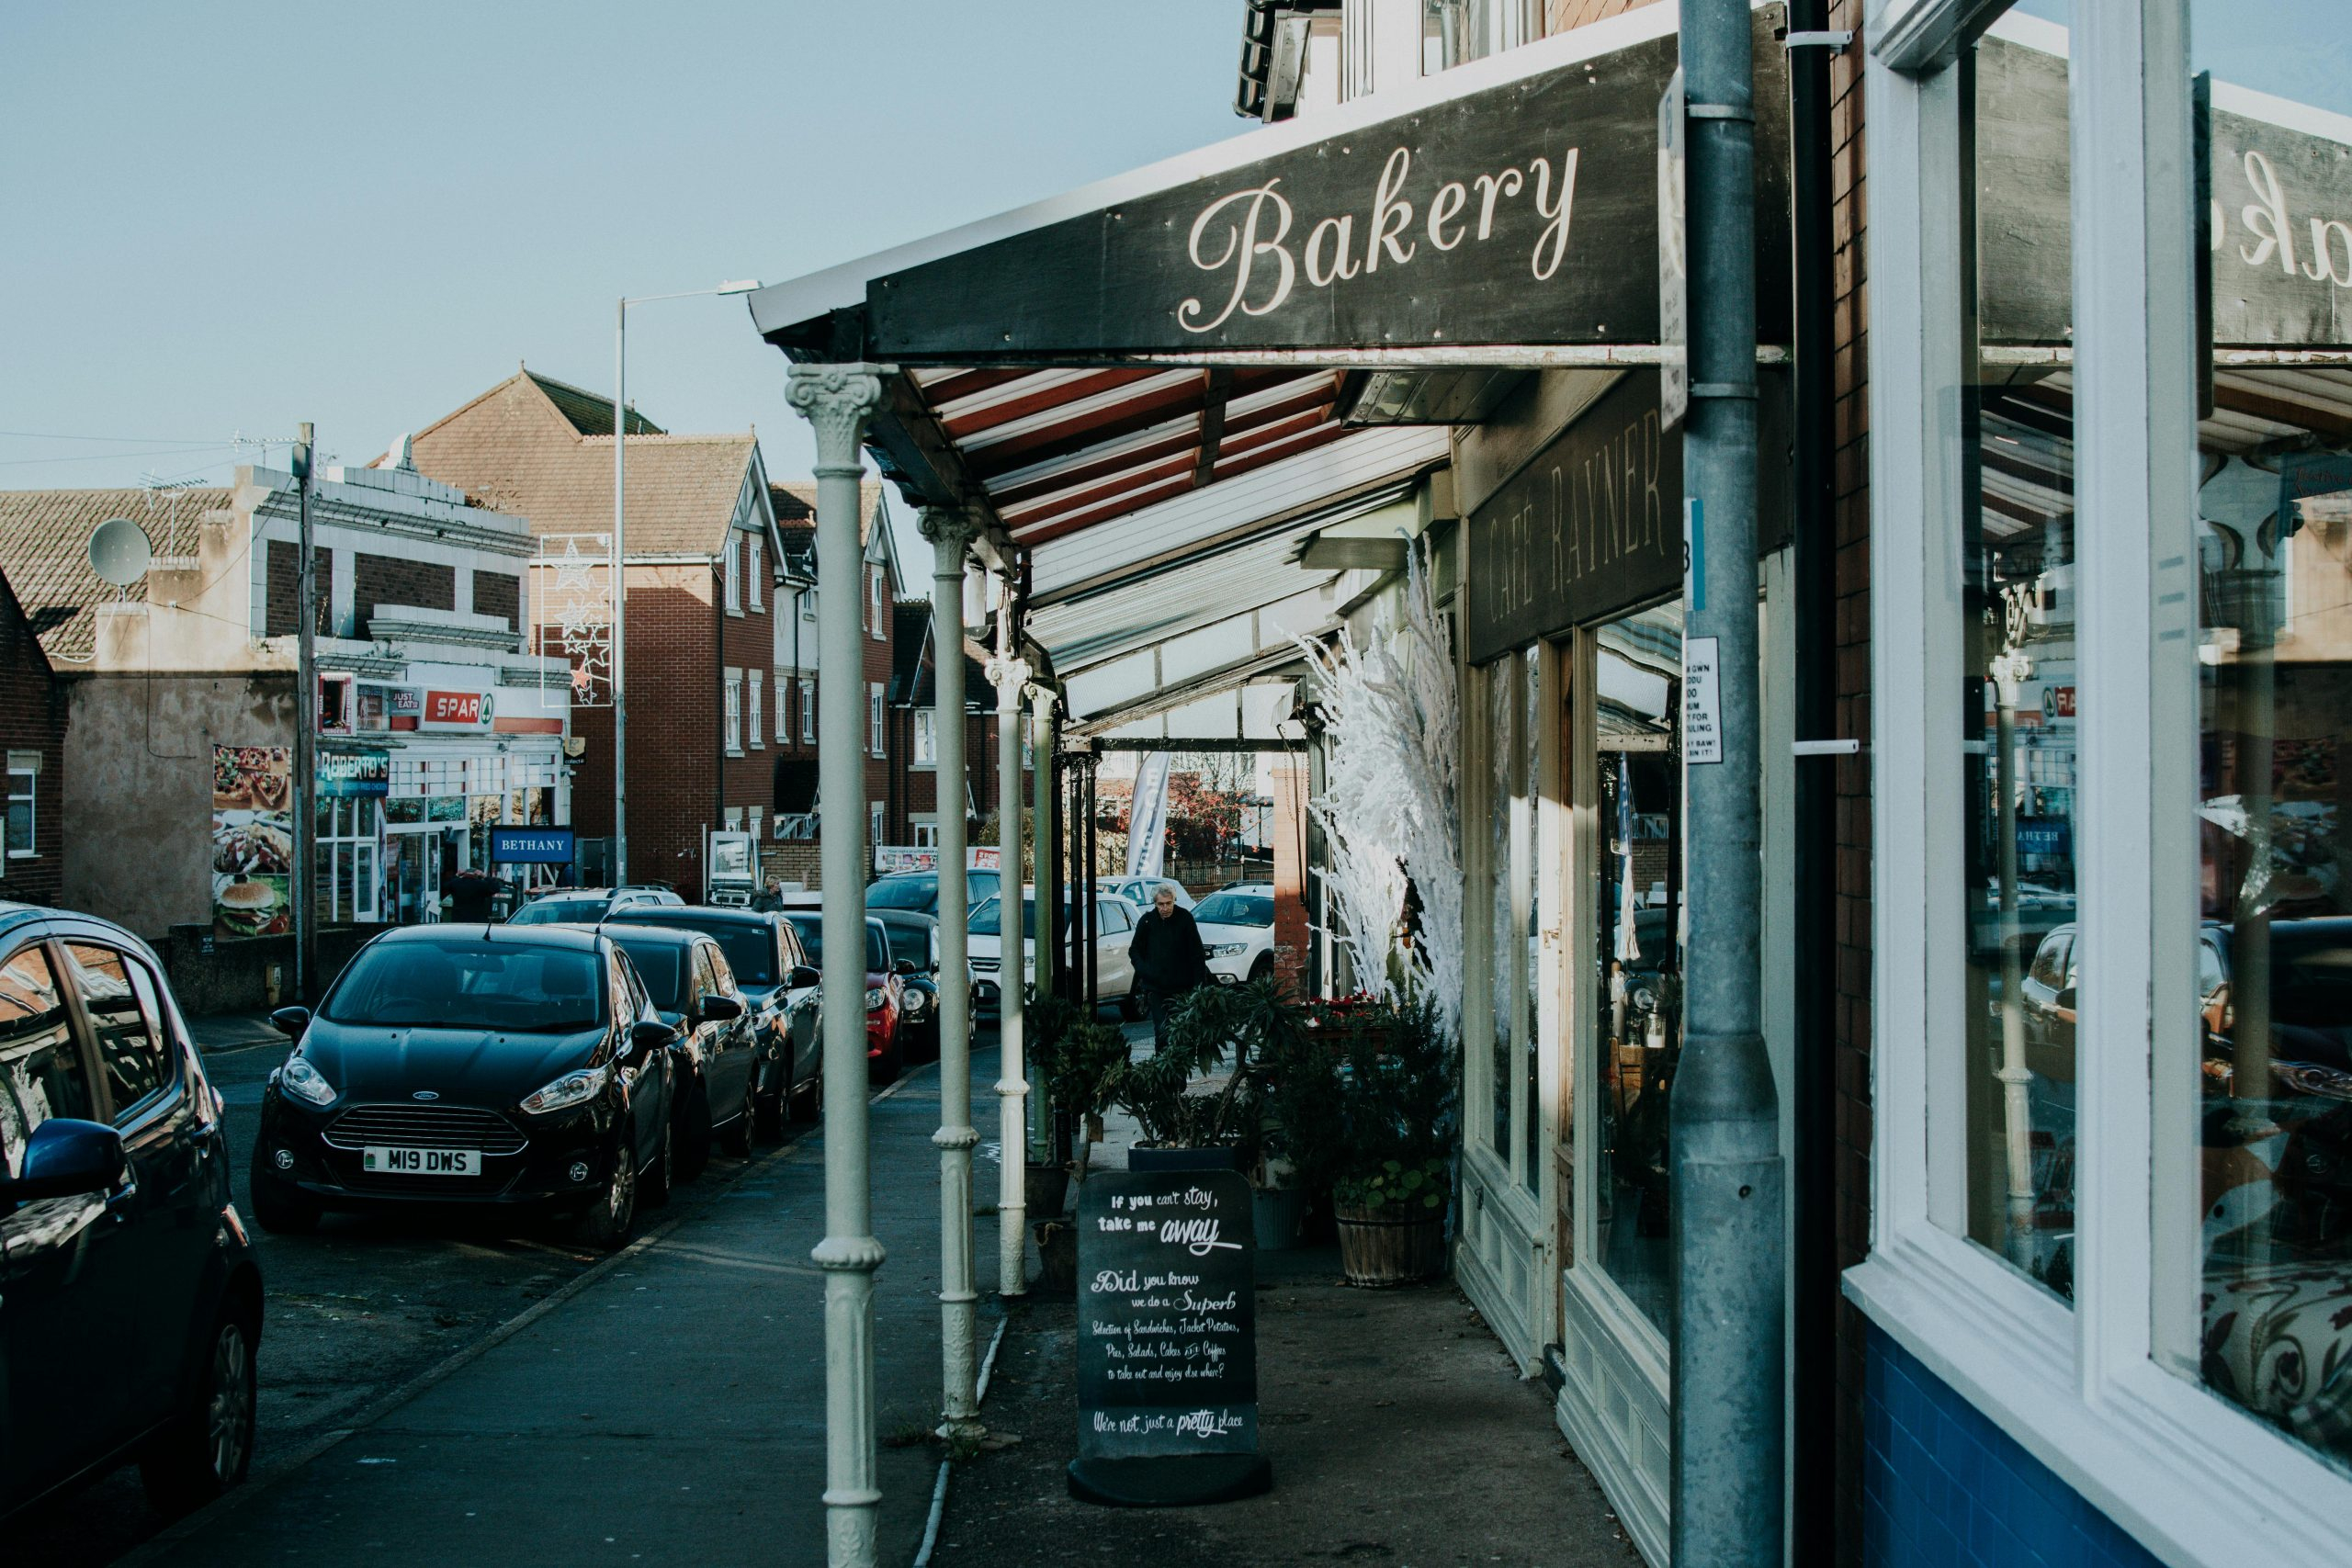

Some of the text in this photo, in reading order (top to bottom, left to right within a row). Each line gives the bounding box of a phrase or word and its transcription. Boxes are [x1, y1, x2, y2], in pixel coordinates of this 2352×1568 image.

[1178, 146, 1578, 333] Bakery
[1551, 407, 1665, 604] RAYNER
[393, 693, 413, 701] JUST
[436, 697, 479, 717] SPAR
[321, 751, 389, 781] ROBERTO'S
[502, 840, 565, 851] BETHANY
[389, 1149, 467, 1172] M19 DWS
[1111, 1185, 1218, 1211] If you can't stay,
[1098, 1216, 1242, 1257] take me away
[1091, 1269, 1200, 1293] Did you know
[1131, 1289, 1237, 1316] we do a Superb
[1092, 1317, 1239, 1341] Selection of Sandwiches, Jacket Potatoes,
[1105, 1343, 1125, 1359] Pies,
[1127, 1343, 1157, 1359] Salads,
[1159, 1342, 1182, 1357] Cakes
[1203, 1341, 1227, 1362] Coffees
[1108, 1362, 1225, 1382] to take out and enjoy else where?
[1093, 1408, 1244, 1438] We're not just a pretty place
